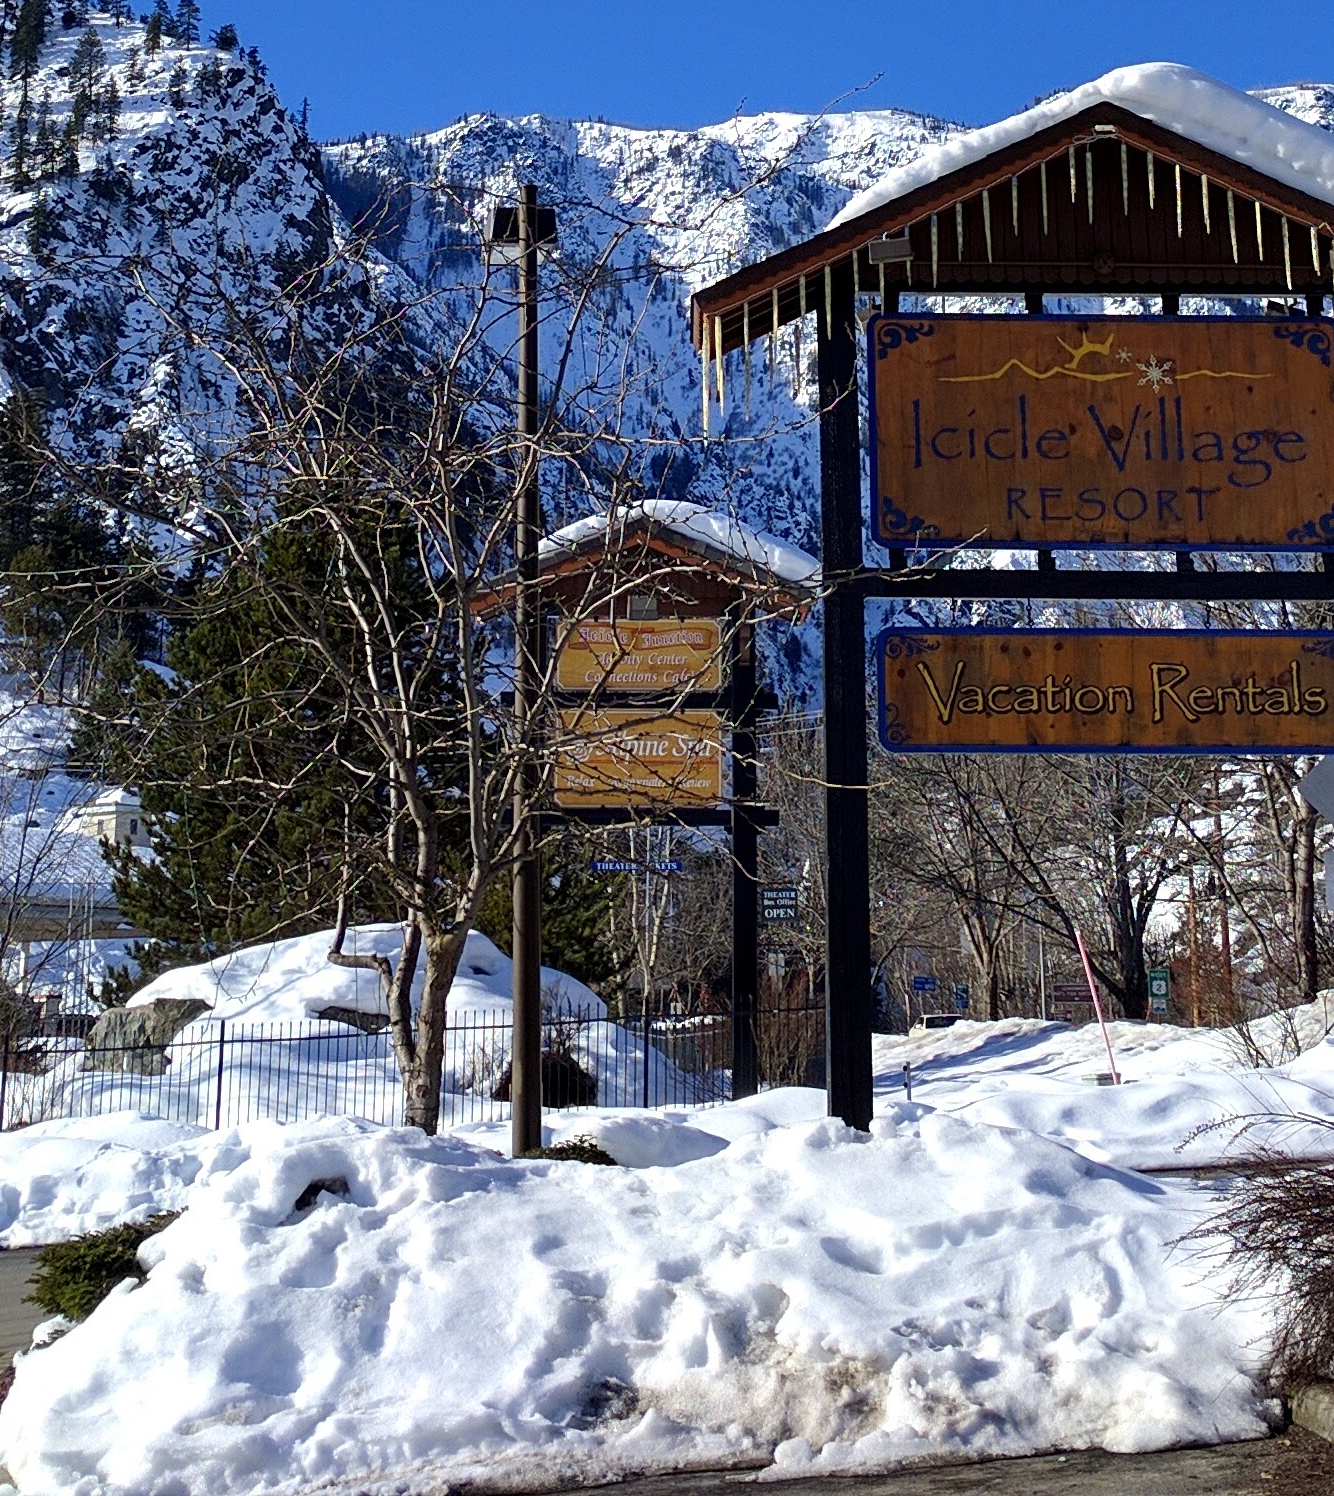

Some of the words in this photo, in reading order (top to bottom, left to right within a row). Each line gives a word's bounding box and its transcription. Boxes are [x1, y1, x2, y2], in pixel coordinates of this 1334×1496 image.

[908, 394, 1070, 468] Icicle
[1087, 395, 1307, 488] Village
[1006, 486, 1217, 523] RESORT
[579, 626, 627, 644] Icice
[648, 652, 688, 665] Center
[584, 669, 658, 683] Conections
[917, 659, 1135, 725] Vacation
[1150, 658, 1329, 724] Rentals
[764, 908, 796, 918] OPEN
[1156, 983, 1163, 992] 2
